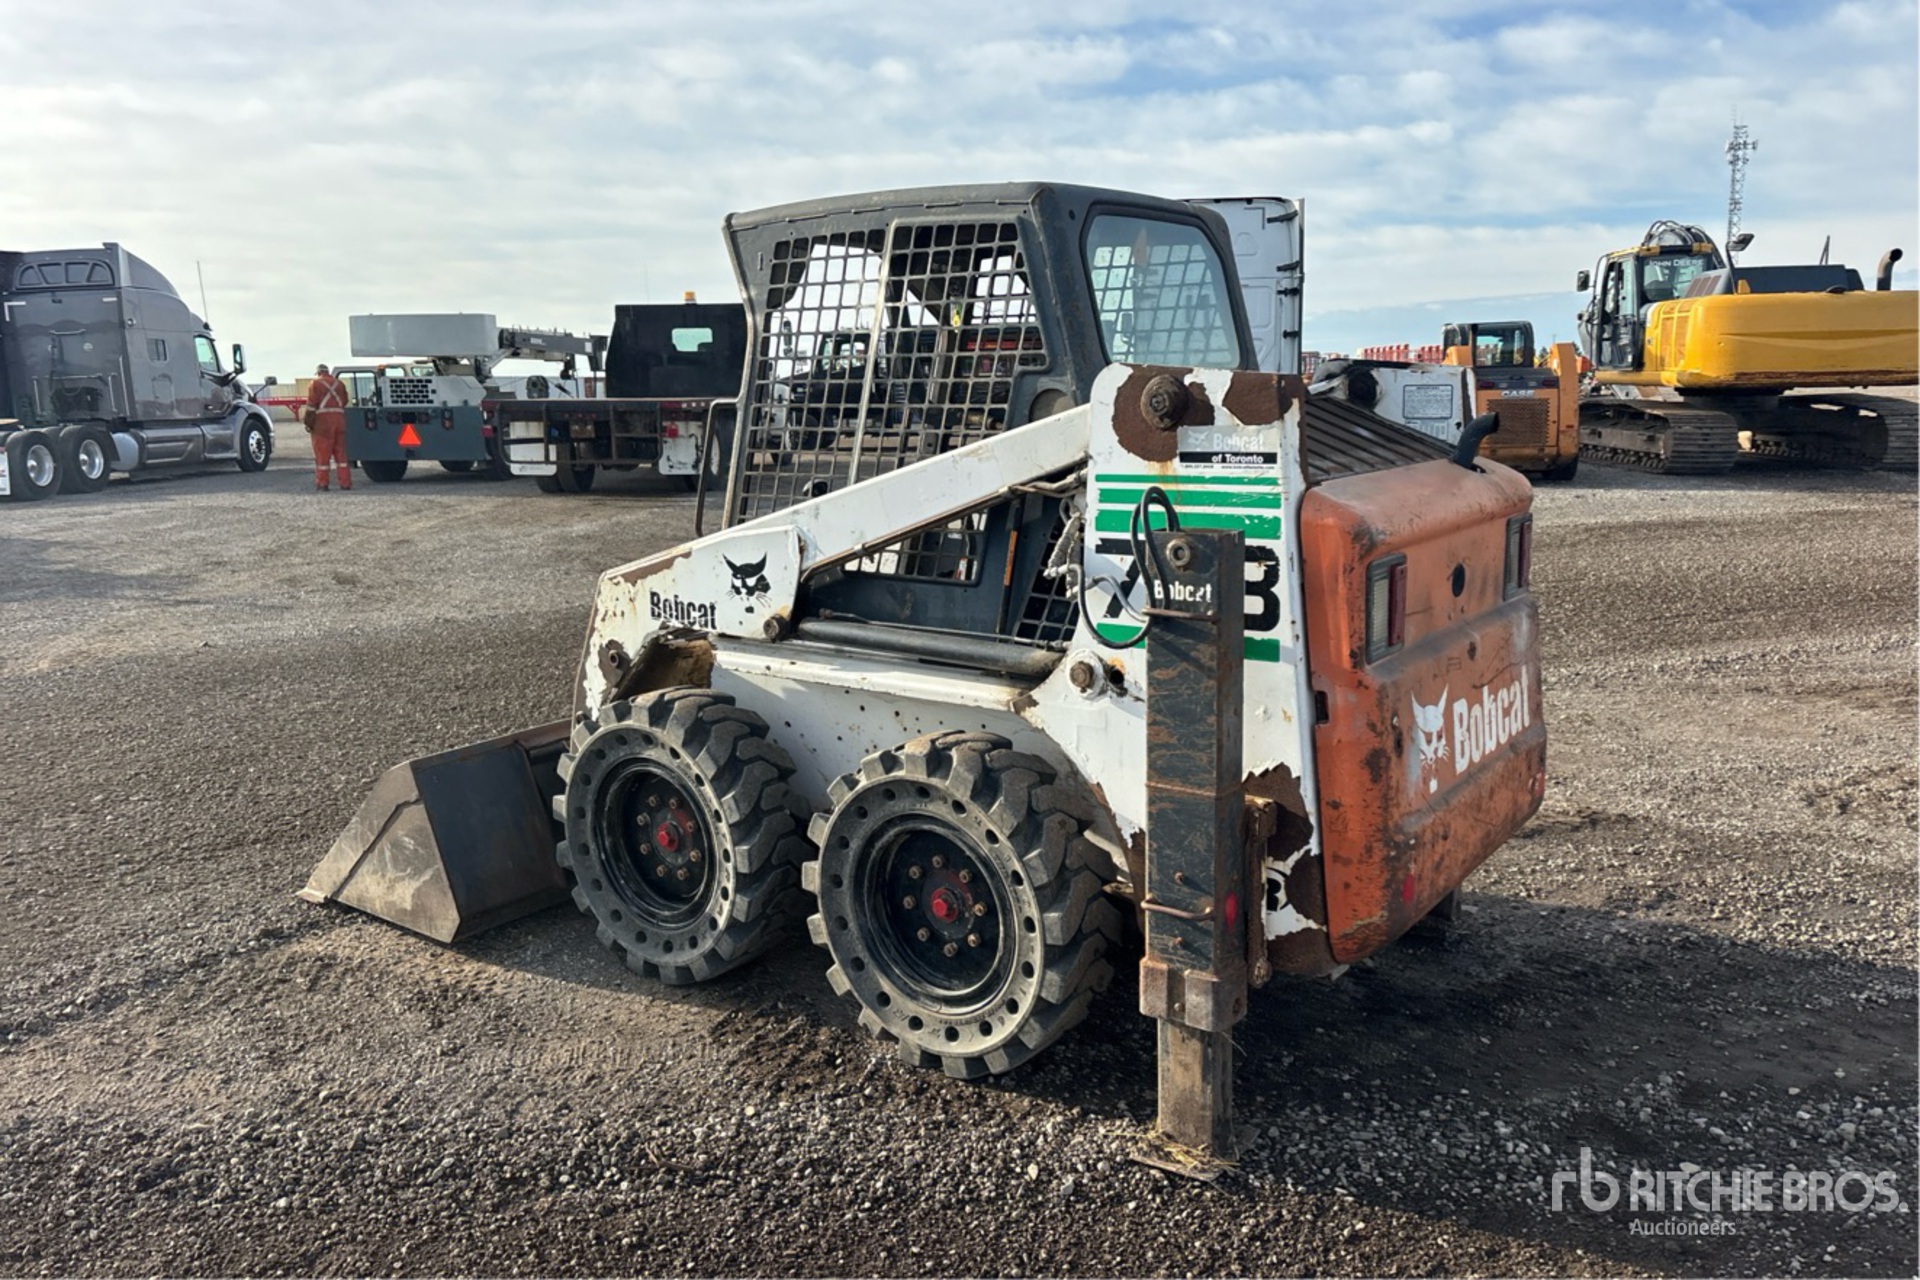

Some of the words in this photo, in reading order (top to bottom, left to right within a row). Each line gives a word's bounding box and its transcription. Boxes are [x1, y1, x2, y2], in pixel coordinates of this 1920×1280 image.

[1501, 389, 1535, 397] CASE
[1213, 433, 1264, 451] Bobcat
[1211, 454, 1222, 463] of
[1224, 454, 1264, 464] Toronto
[650, 591, 717, 630] Bobcat
[1453, 665, 1530, 775] Bobcat
